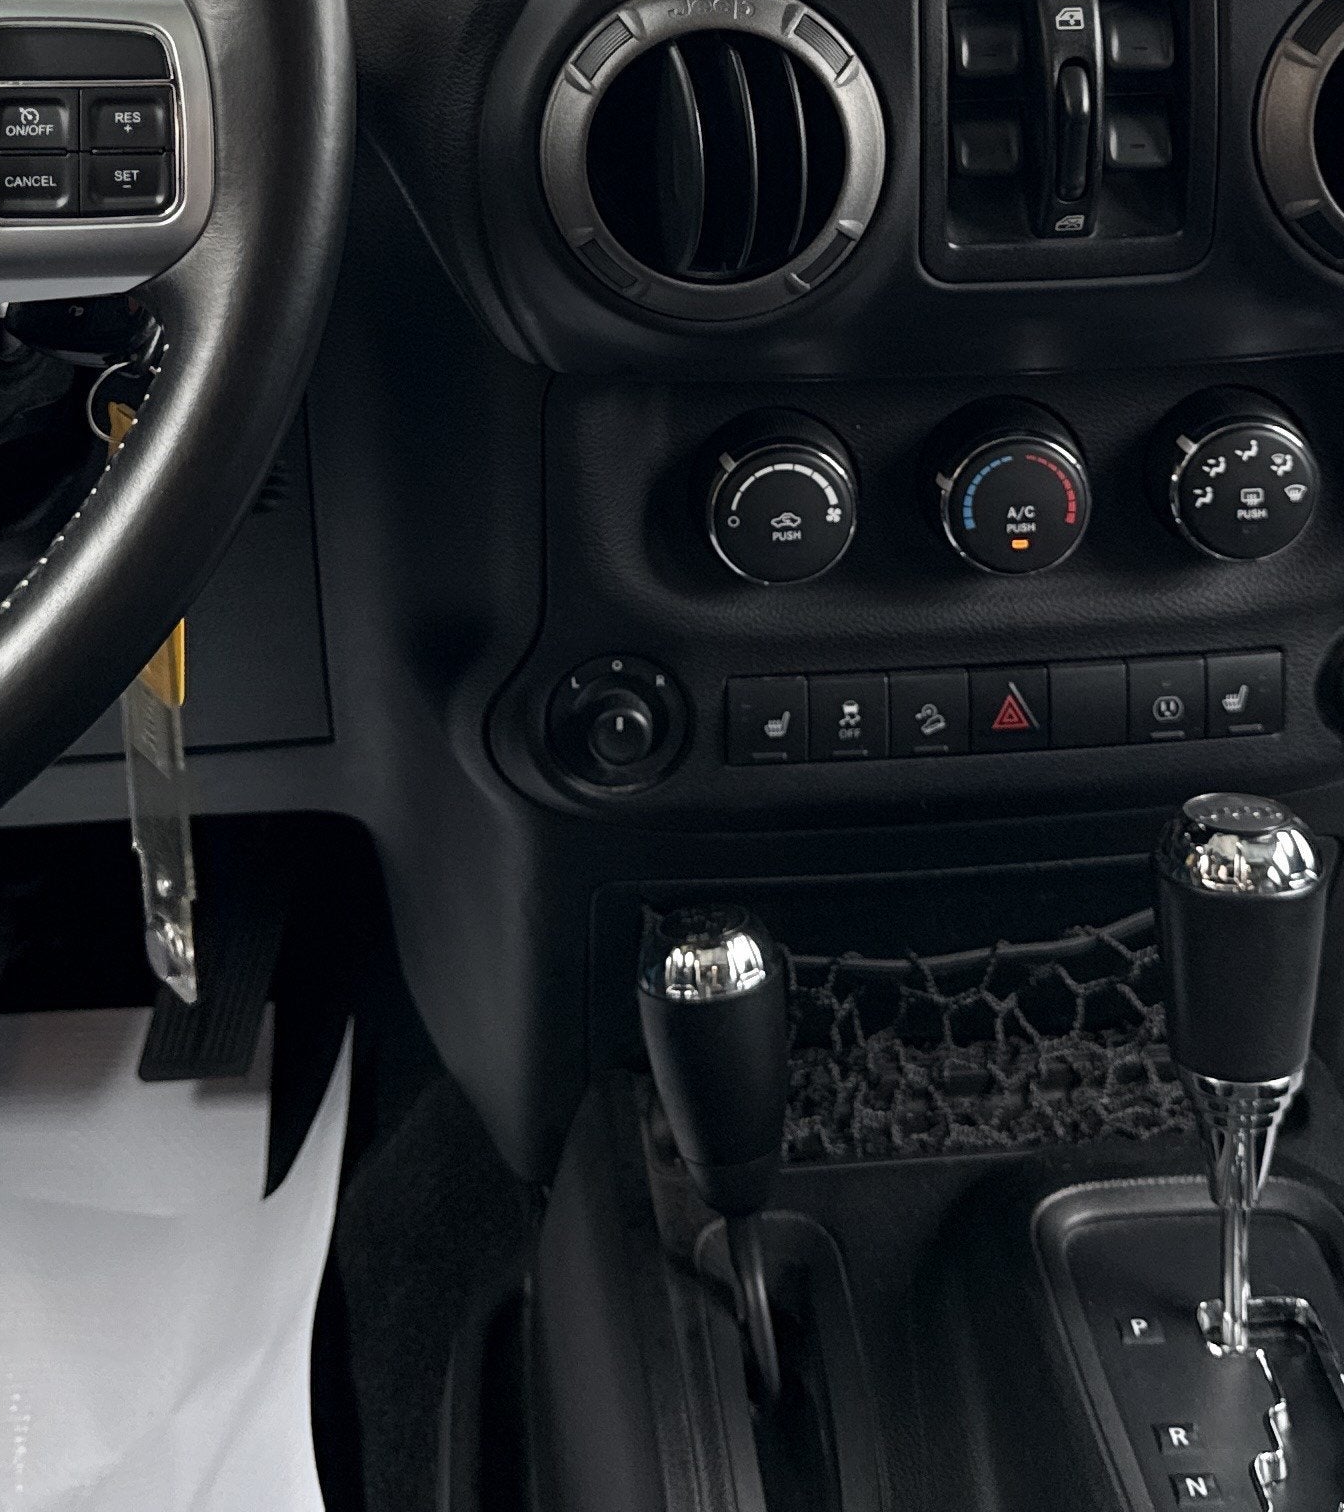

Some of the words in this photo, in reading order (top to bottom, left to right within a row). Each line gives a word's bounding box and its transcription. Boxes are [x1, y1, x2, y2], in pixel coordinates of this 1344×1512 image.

[114, 111, 142, 124] RES
[5, 124, 54, 137] ON/OFF
[5, 176, 57, 188] CANCEL
[114, 170, 140, 183] SET
[1006, 504, 1036, 522] A/C
[1236, 506, 1268, 521] PUSH
[772, 528, 802, 542] PUSH
[1006, 521, 1036, 535] PUSH
[1130, 1317, 1148, 1337] P
[1168, 1426, 1189, 1447] R
[1185, 1476, 1208, 1497] N
